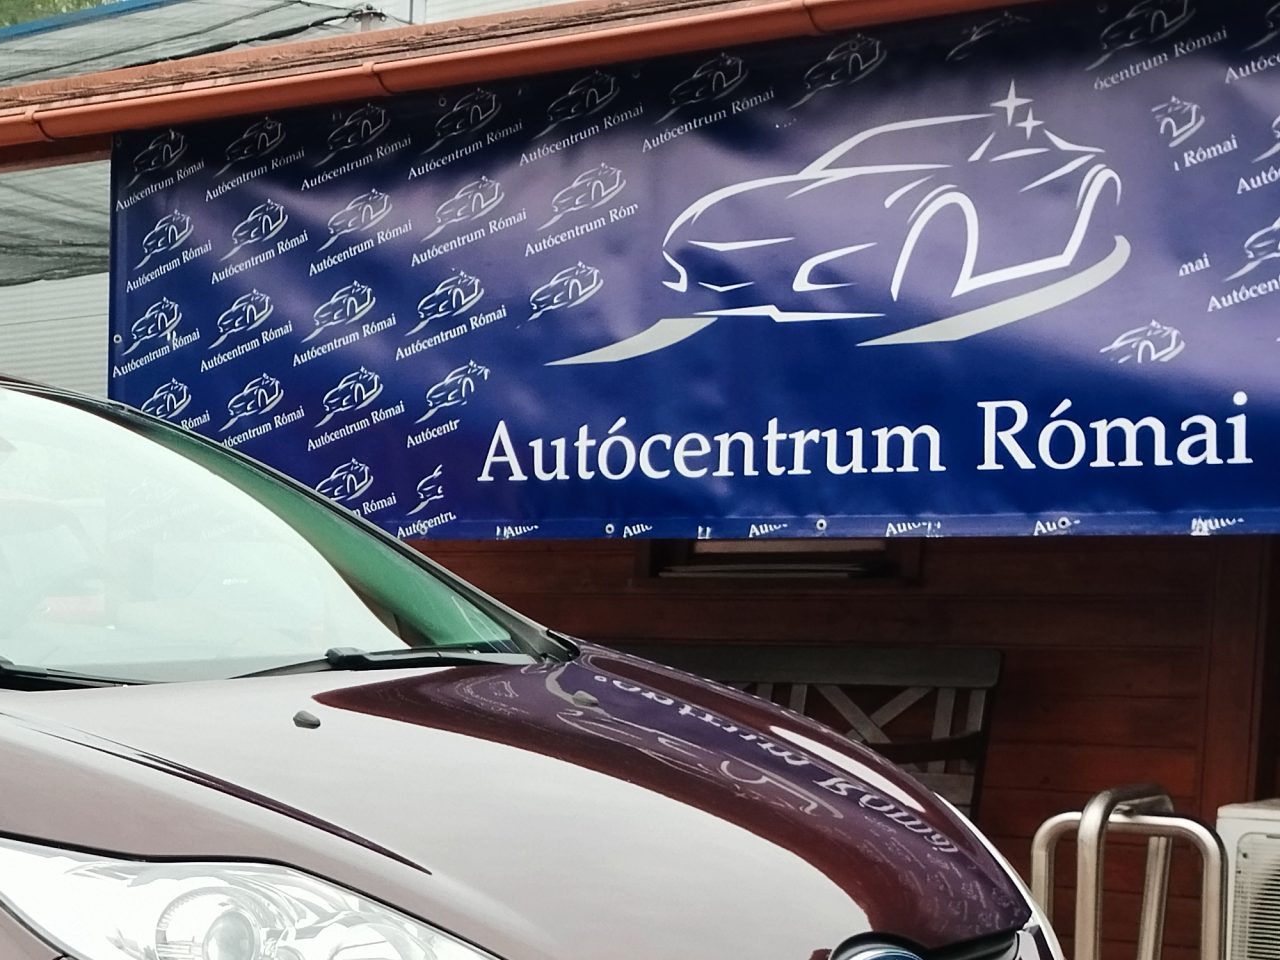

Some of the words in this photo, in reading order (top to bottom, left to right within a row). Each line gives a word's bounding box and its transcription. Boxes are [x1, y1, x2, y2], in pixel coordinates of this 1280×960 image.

[1173, 25, 1228, 58] Római
[520, 126, 600, 167] Autócentrum
[603, 103, 644, 130] Római
[642, 110, 728, 153] Autócentrum
[731, 88, 775, 114] Római
[205, 166, 268, 202] Autócentrum
[271, 148, 306, 170] Római
[301, 154, 373, 191] Autócentrum
[376, 135, 412, 160] Római
[407, 140, 483, 180] Autócentrum
[486, 120, 523, 145] Római
[1183, 133, 1238, 168] Római
[115, 177, 174, 212] Autócentrum
[176, 160, 205, 181] Római
[210, 250, 272, 285] Autócentrum
[276, 228, 309, 255] Római
[308, 240, 375, 277] Autócentrum
[377, 219, 412, 244] Római
[411, 228, 486, 267] Autócentrum
[488, 208, 527, 235] Római
[525, 216, 606, 257] Autócentrum
[125, 258, 181, 293] Autócentrum
[182, 239, 213, 264] Római
[112, 344, 171, 378] Autócentrum
[172, 327, 201, 350] Római
[200, 337, 260, 373] Autócentrum
[262, 321, 293, 344] Római
[292, 330, 360, 367] Autócentrum
[363, 313, 397, 337] Római
[395, 322, 468, 361] Autócentrum
[470, 304, 507, 330] Római
[180, 410, 211, 430] Római
[273, 405, 305, 428] Római
[307, 416, 370, 452] Autócentrum
[371, 400, 405, 425] Római
[477, 415, 946, 483] Autócentrum
[976, 391, 1253, 471] Római
[362, 492, 397, 515] Római
